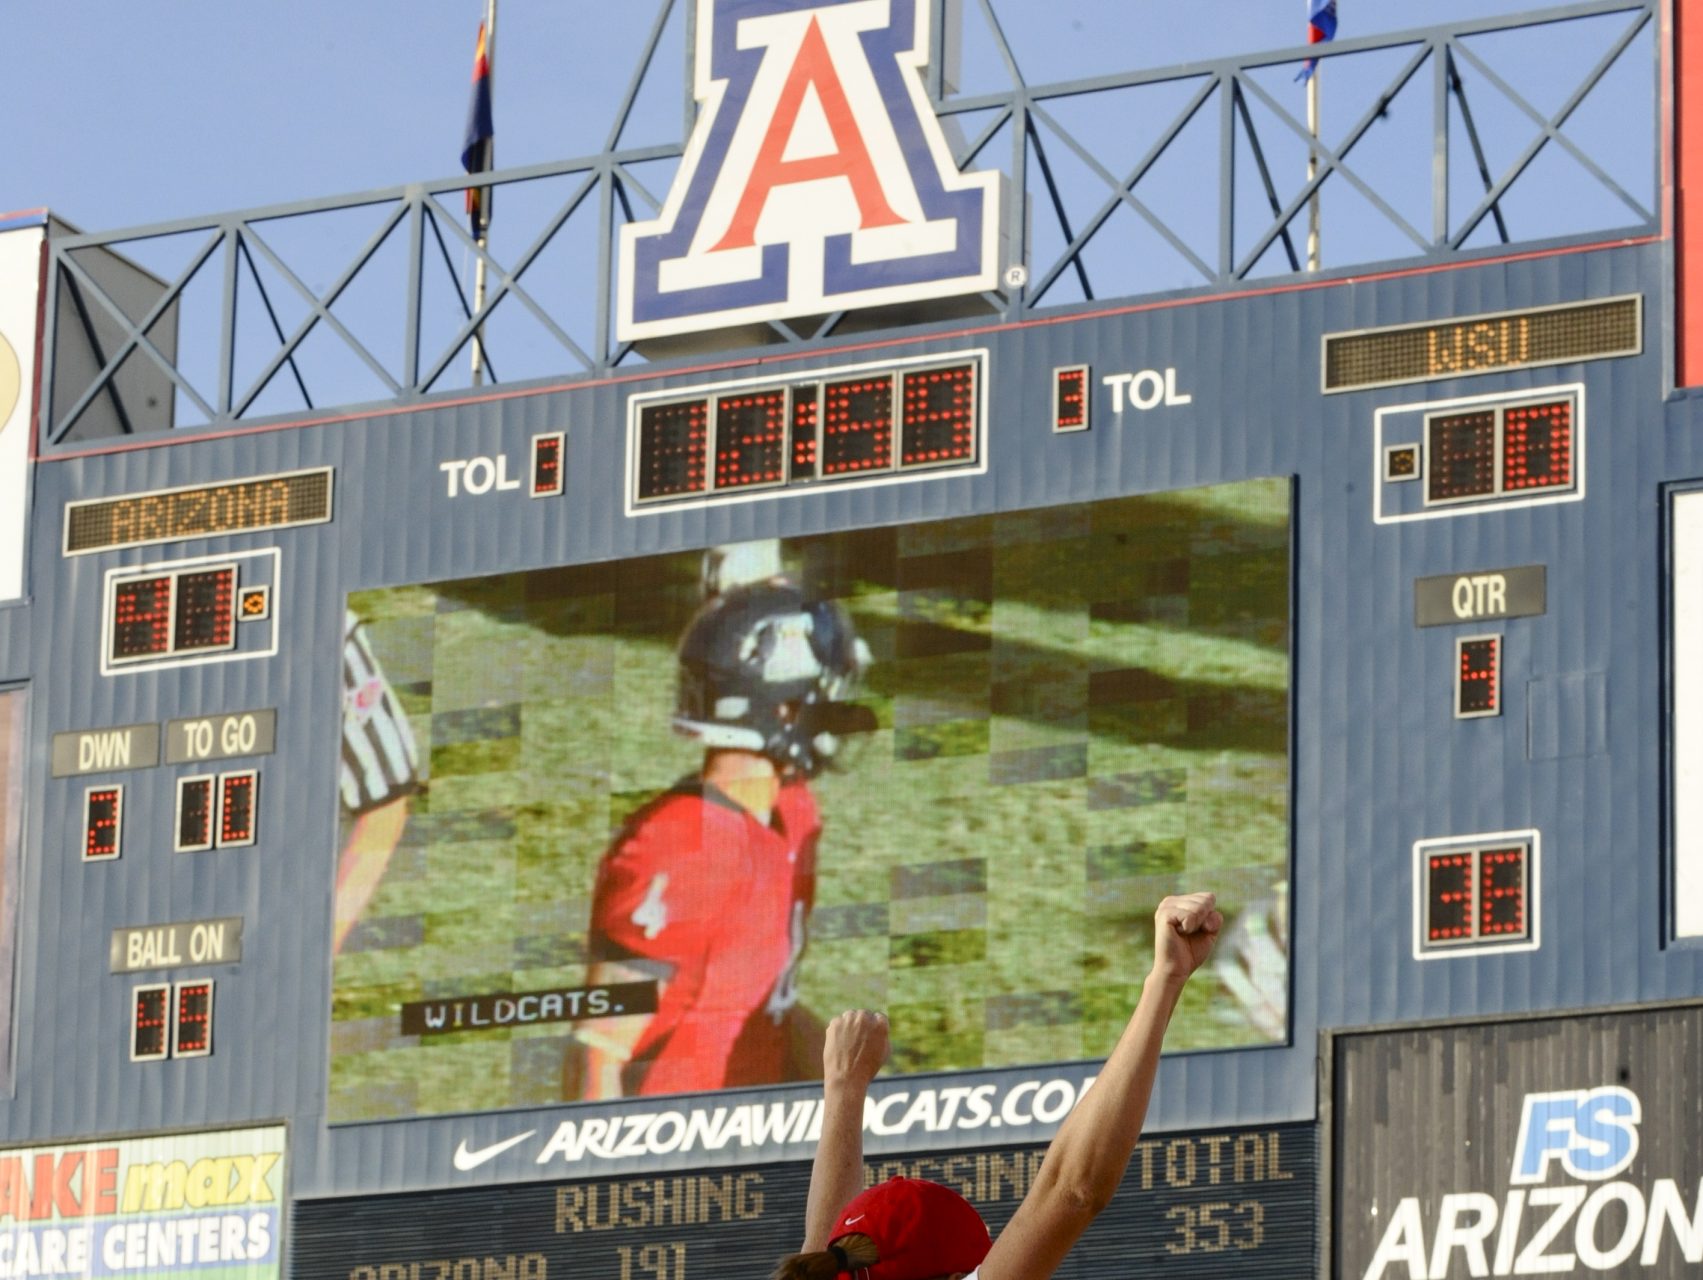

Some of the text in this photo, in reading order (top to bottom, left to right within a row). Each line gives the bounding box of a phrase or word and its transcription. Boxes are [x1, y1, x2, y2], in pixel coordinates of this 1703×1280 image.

[618, 0, 1000, 341] A
[1427, 317, 1529, 376] WSU
[1058, 370, 1085, 426] 3
[1102, 367, 1192, 414] TOL
[440, 454, 521, 498] TOL
[534, 438, 559, 492] 3
[111, 480, 289, 545] ARIZONA
[1451, 574, 1507, 619] QTR
[1460, 640, 1496, 707] 4
[78, 731, 132, 771] DWN
[183, 714, 257, 758] TO GO
[87, 791, 119, 856] 2
[1429, 850, 1523, 939] 36
[126, 924, 225, 969] BALL ON
[137, 985, 210, 1053] 45
[1509, 1085, 1642, 1185] FS
[121, 1152, 283, 1214] max
[555, 1172, 766, 1234] RUSHING
[1135, 1131, 1294, 1190] TOTAL
[103, 1213, 272, 1270] CENTERS
[1165, 1200, 1266, 1255] 353
